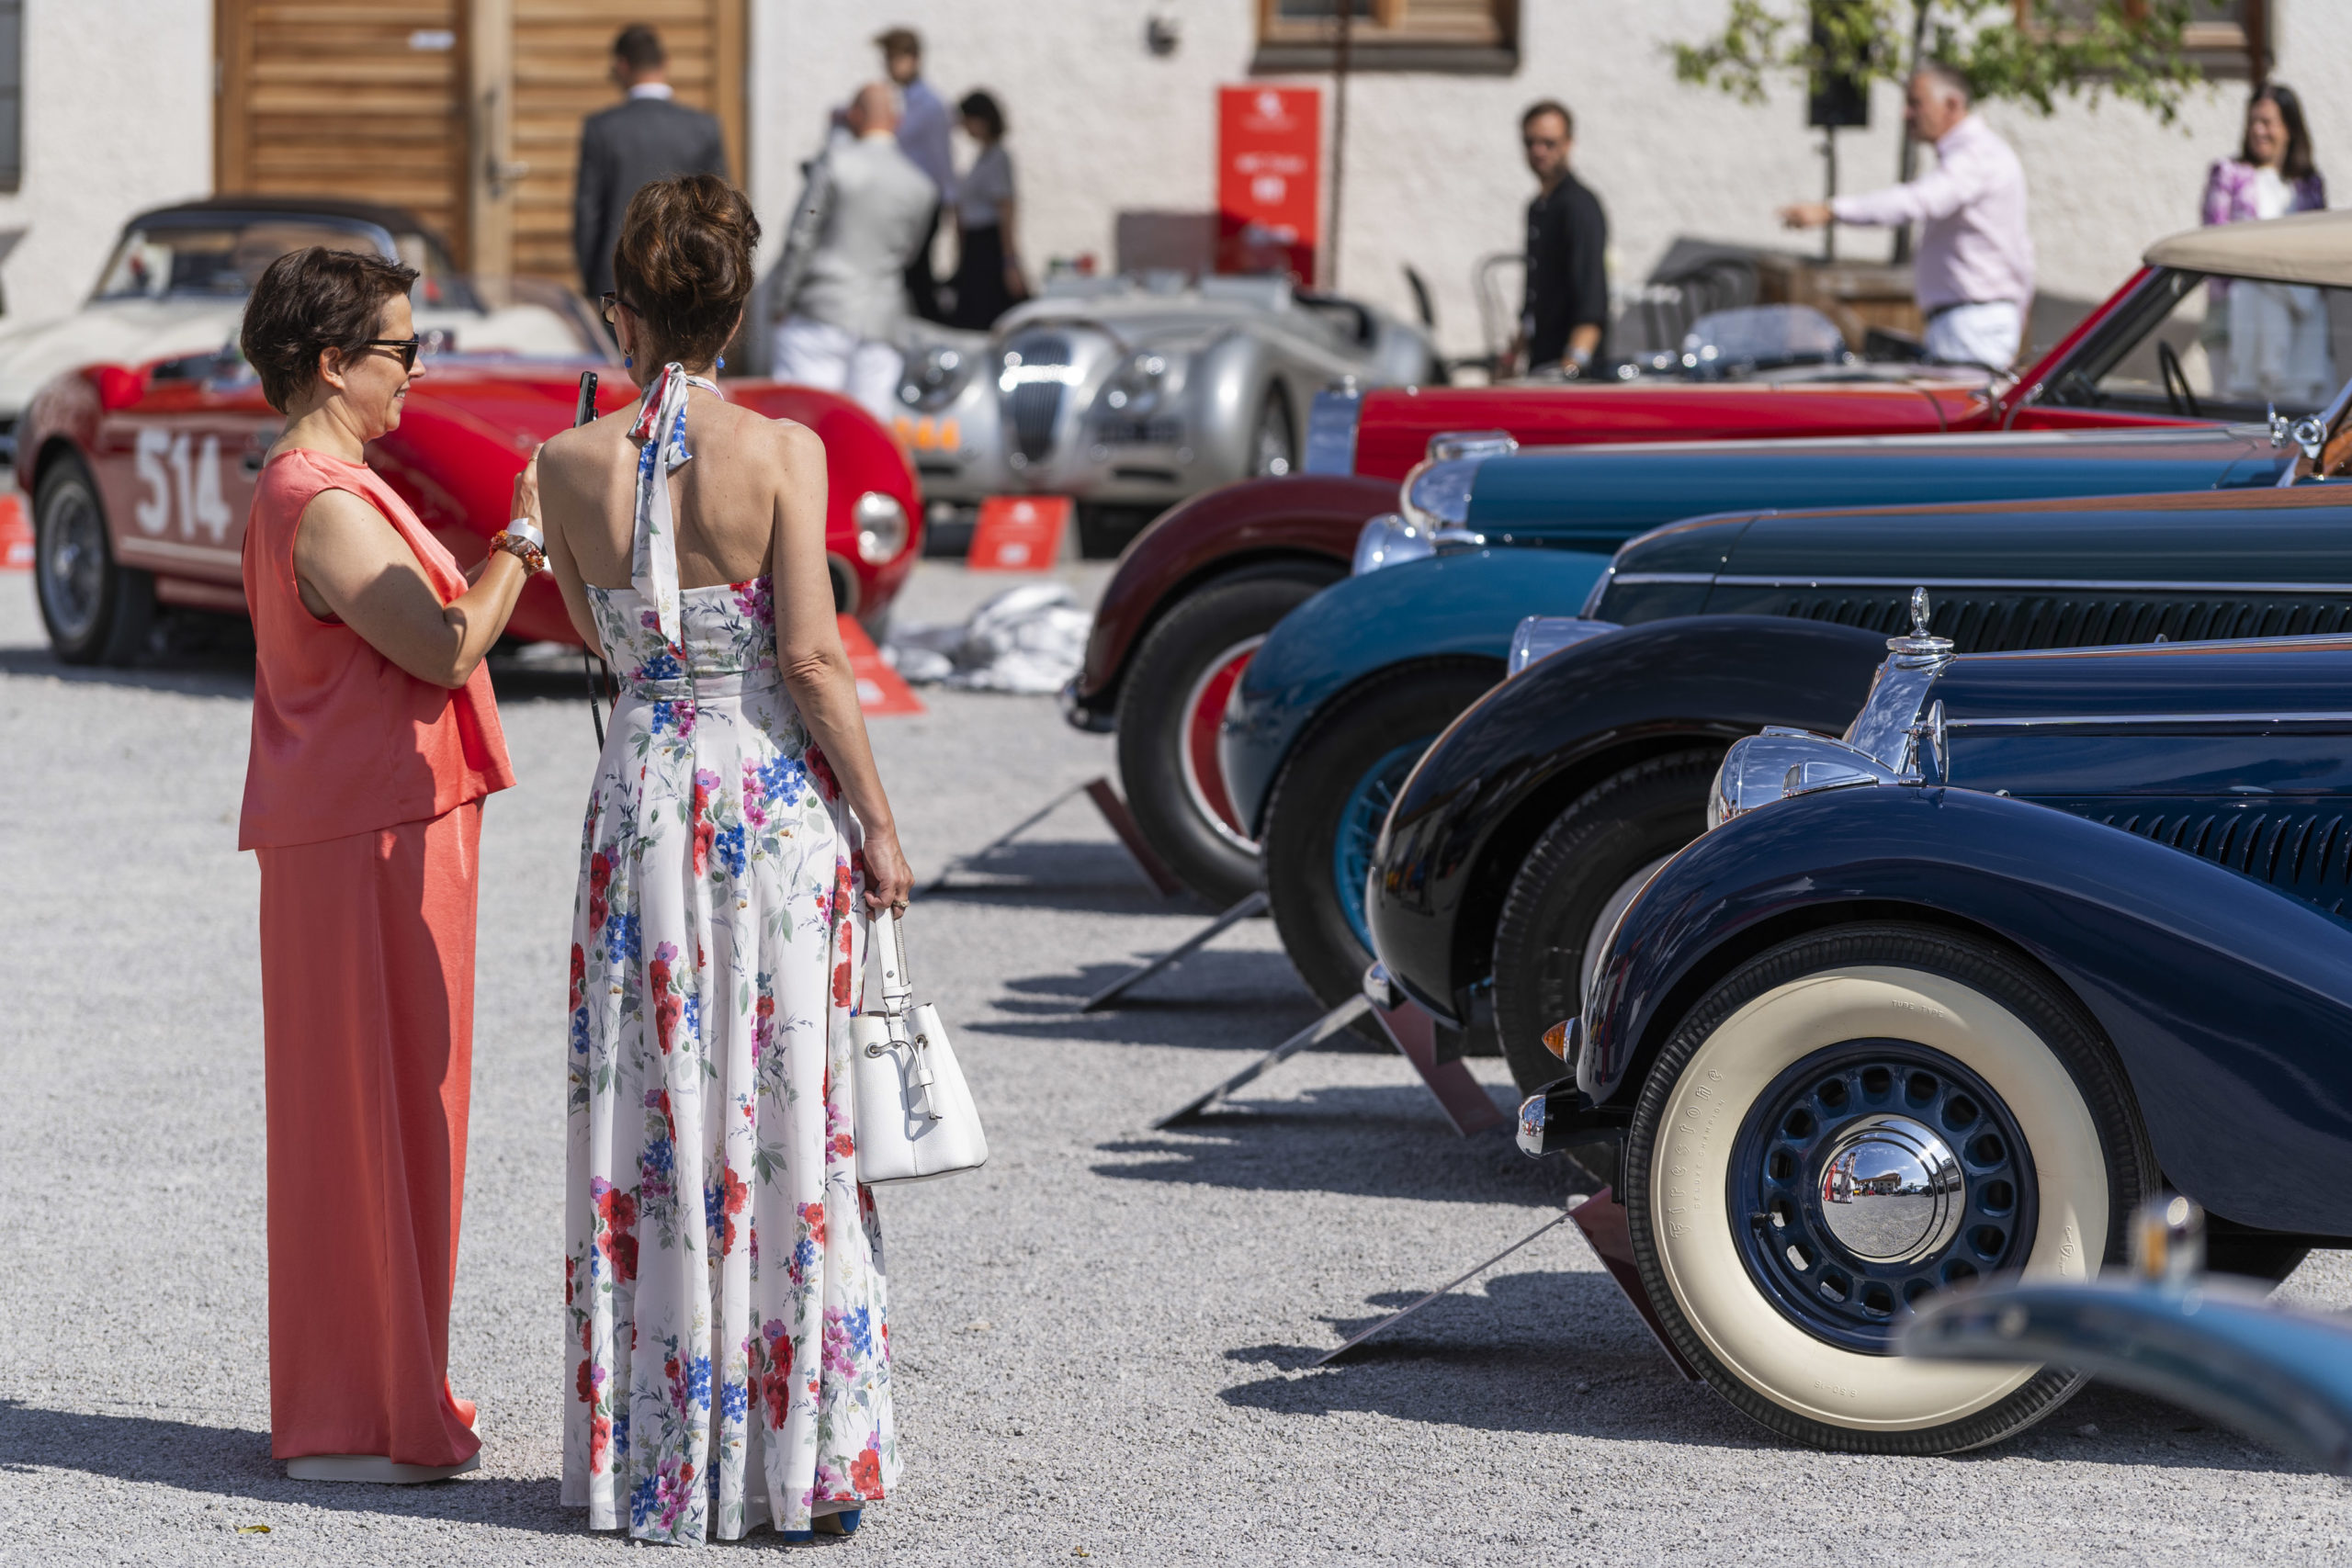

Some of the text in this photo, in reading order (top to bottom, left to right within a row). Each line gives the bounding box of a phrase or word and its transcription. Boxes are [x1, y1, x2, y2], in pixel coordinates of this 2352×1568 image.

[136, 429, 232, 542] 514
[1892, 999, 1944, 1018] TUBE TYPE
[1668, 1069, 1723, 1239] Firestone
